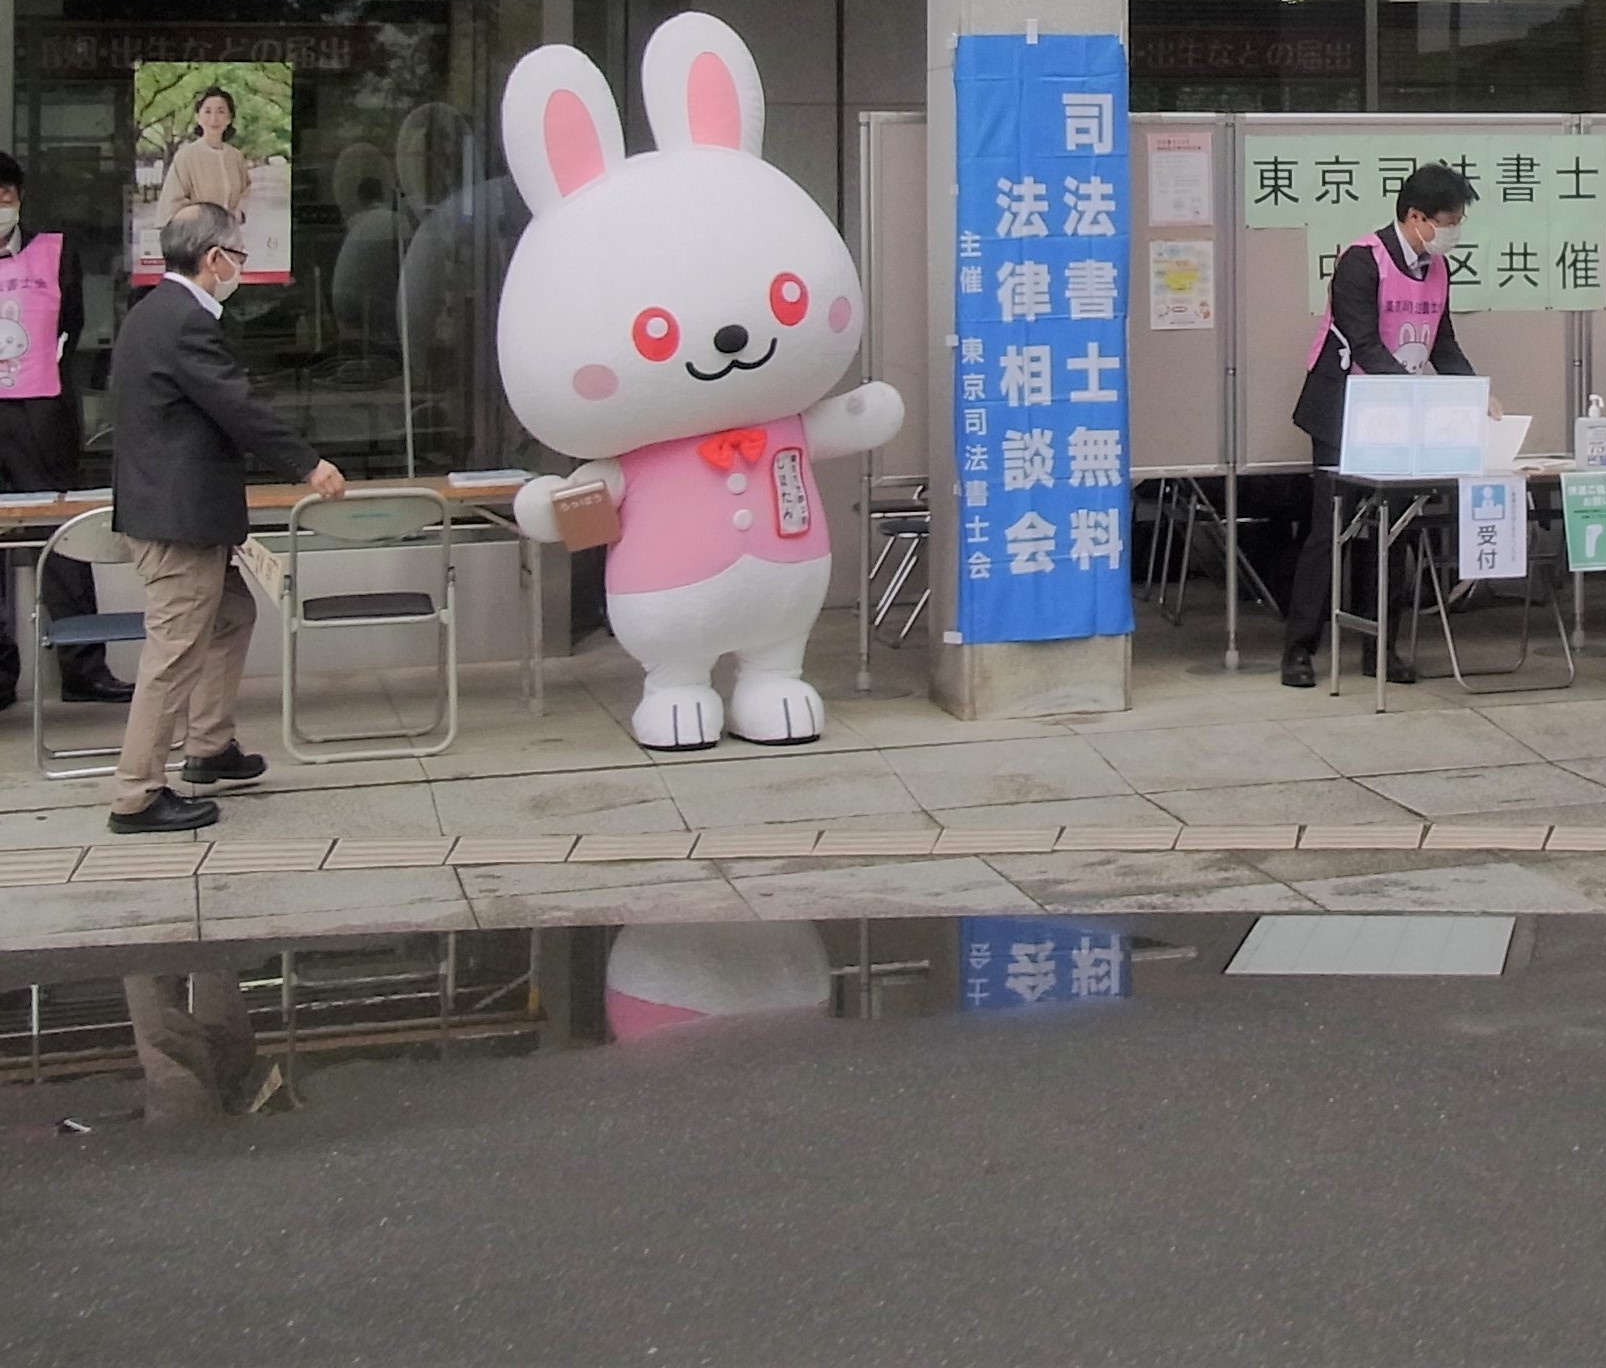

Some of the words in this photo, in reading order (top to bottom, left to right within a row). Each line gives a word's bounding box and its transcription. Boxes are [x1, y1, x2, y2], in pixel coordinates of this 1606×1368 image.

[960, 230, 983, 296] 主催
[996, 176, 1058, 576] 法律相談会
[1062, 92, 1124, 571] 司法書士無料
[961, 337, 992, 580] 東京司法書士会
[1476, 524, 1498, 571] 受付
